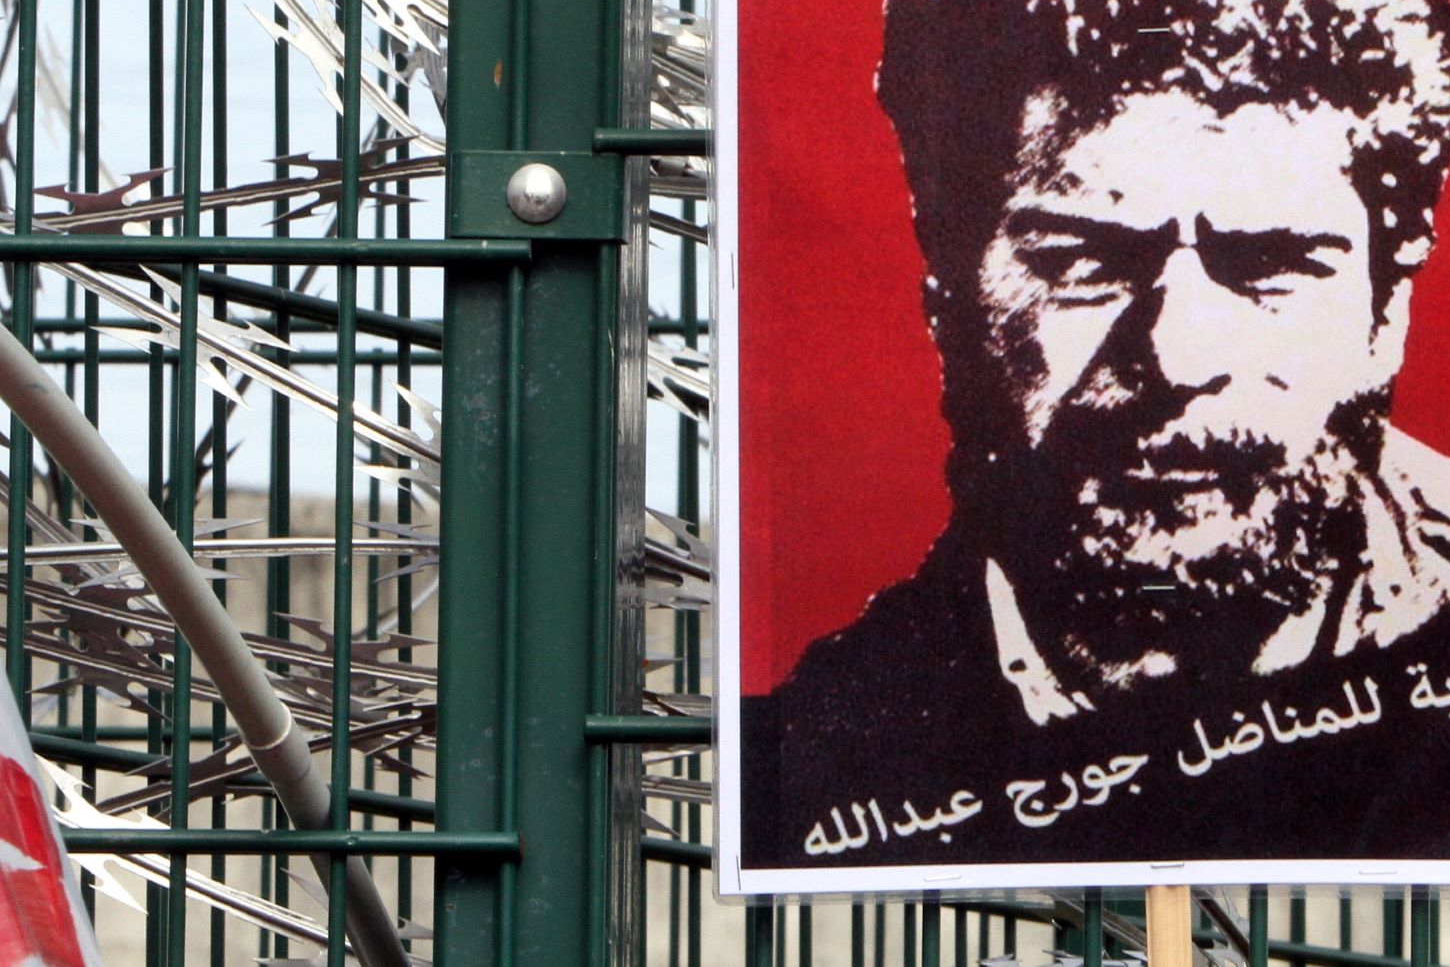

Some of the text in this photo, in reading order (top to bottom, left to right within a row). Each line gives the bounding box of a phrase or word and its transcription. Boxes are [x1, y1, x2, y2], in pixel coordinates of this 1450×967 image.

[1177, 676, 1382, 777] للمناضل
[803, 790, 983, 856] عبدالله
[1005, 754, 1149, 828] جورج
